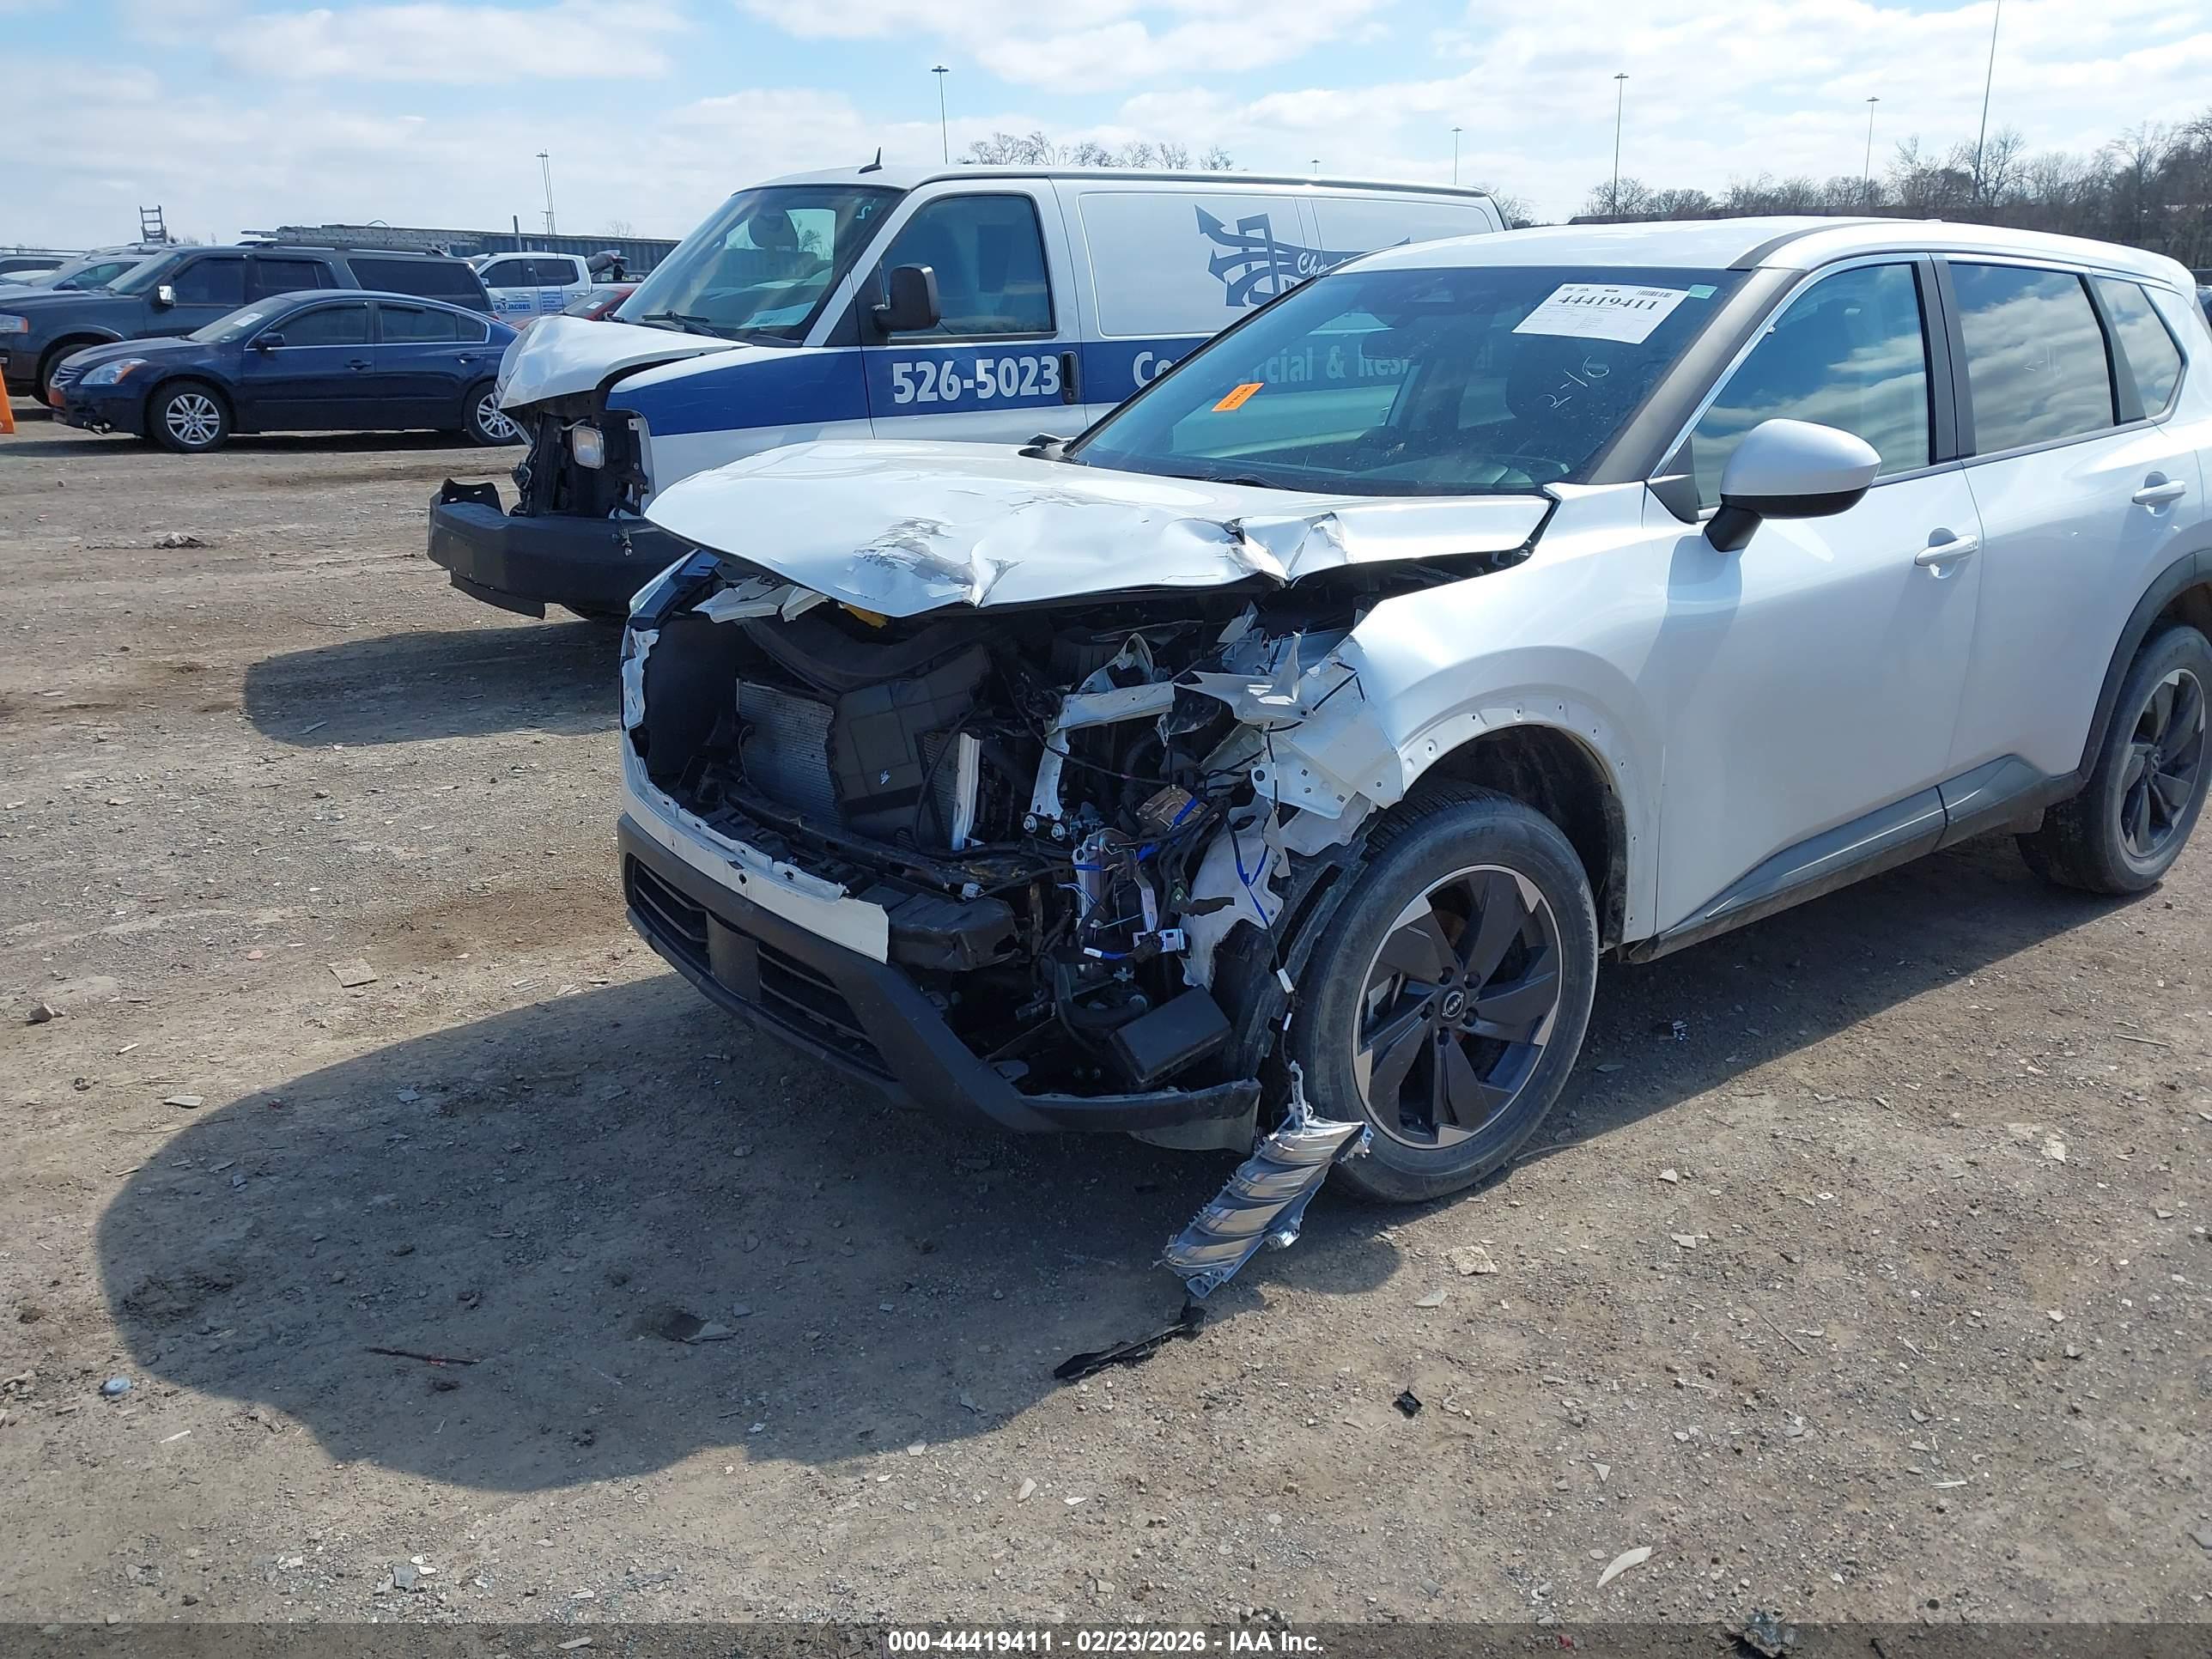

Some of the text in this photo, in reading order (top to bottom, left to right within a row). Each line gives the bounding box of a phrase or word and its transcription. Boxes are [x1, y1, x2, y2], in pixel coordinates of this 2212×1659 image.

[1557, 295, 1660, 310] 44419411
[1326, 345, 1346, 379] &
[892, 356, 1060, 404] 526-5023
